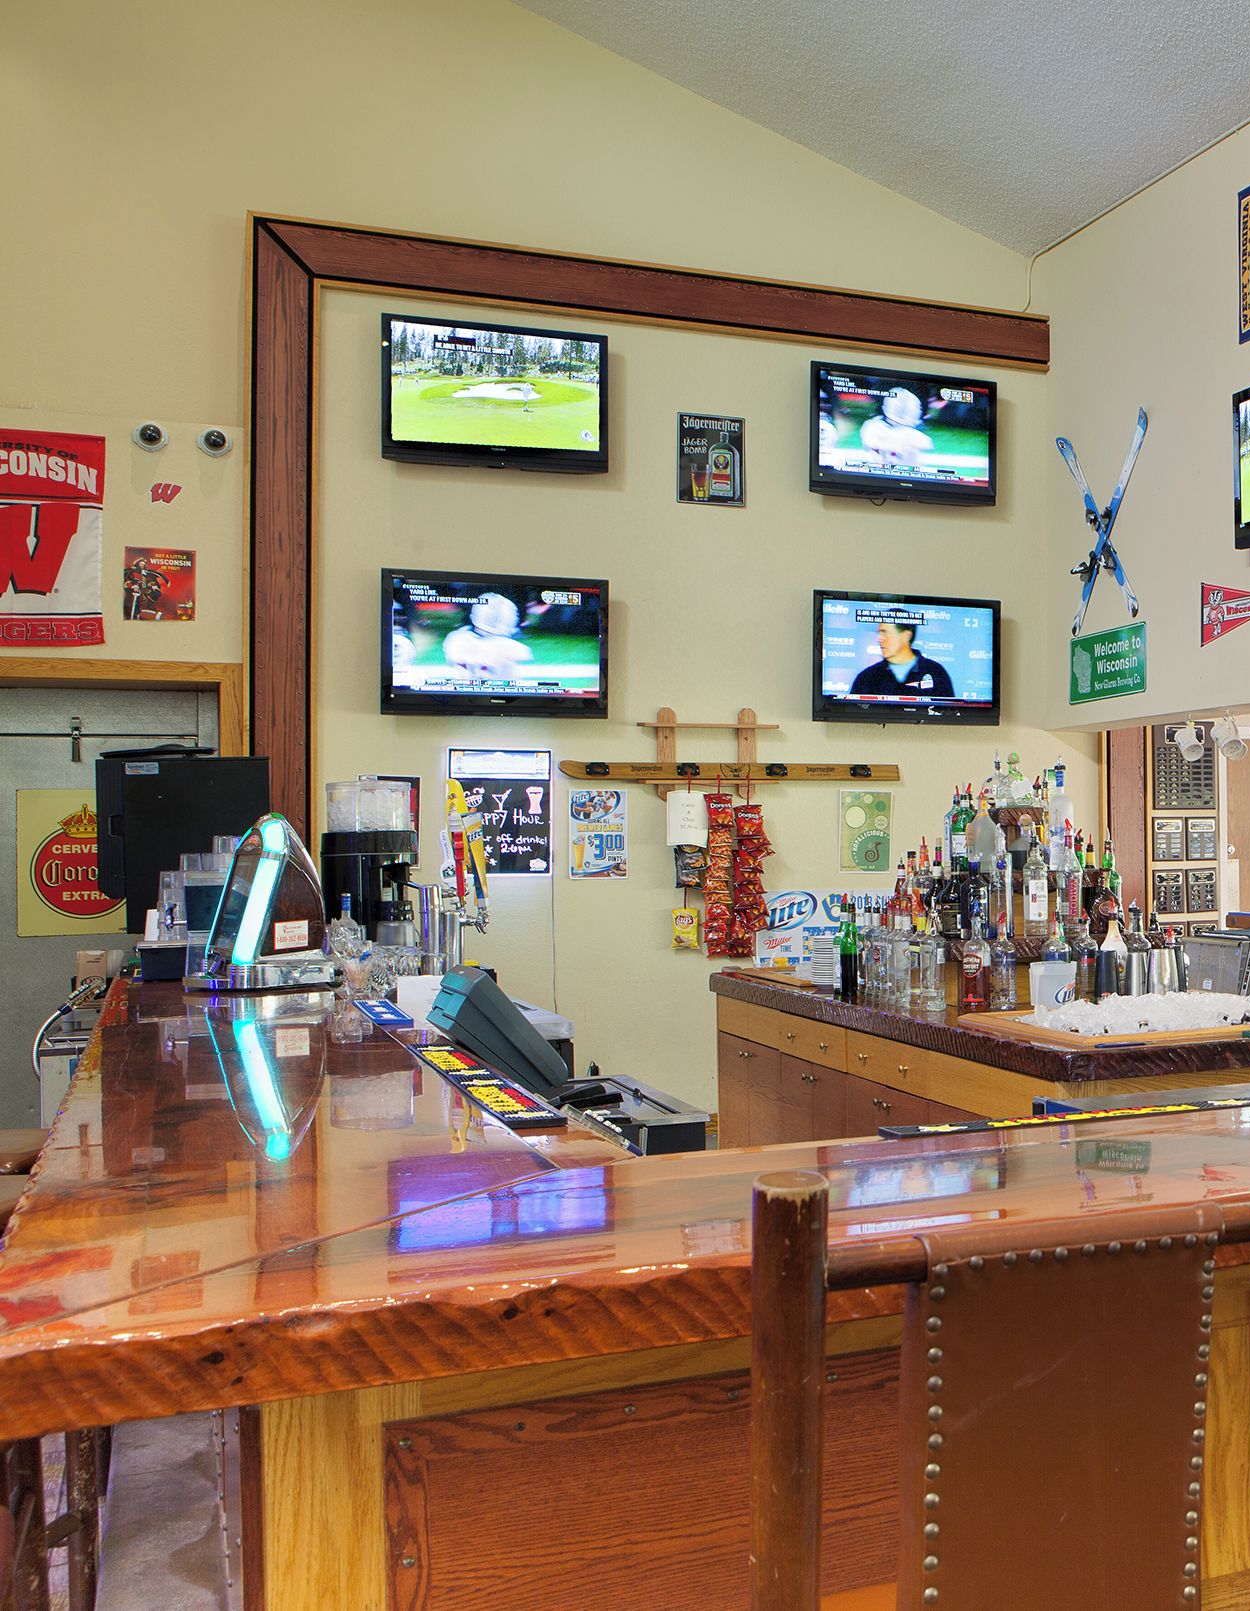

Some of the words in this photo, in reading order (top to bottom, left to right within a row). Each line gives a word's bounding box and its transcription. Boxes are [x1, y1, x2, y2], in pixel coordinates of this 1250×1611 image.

[0, 441, 51, 451] RSITY
[57, 450, 78, 460] OF
[684, 446, 707, 454] BOMB
[150, 558, 192, 567] WISCONSIN
[0, 620, 100, 641] GERS
[1094, 640, 1129, 658] Welcome
[1131, 635, 1141, 649] to
[1097, 654, 1138, 674] Wisconsin
[62, 891, 110, 901] EXTRA
[767, 898, 809, 932] Lite
[764, 936, 792, 950] Miller
[780, 945, 792, 953] TIME
